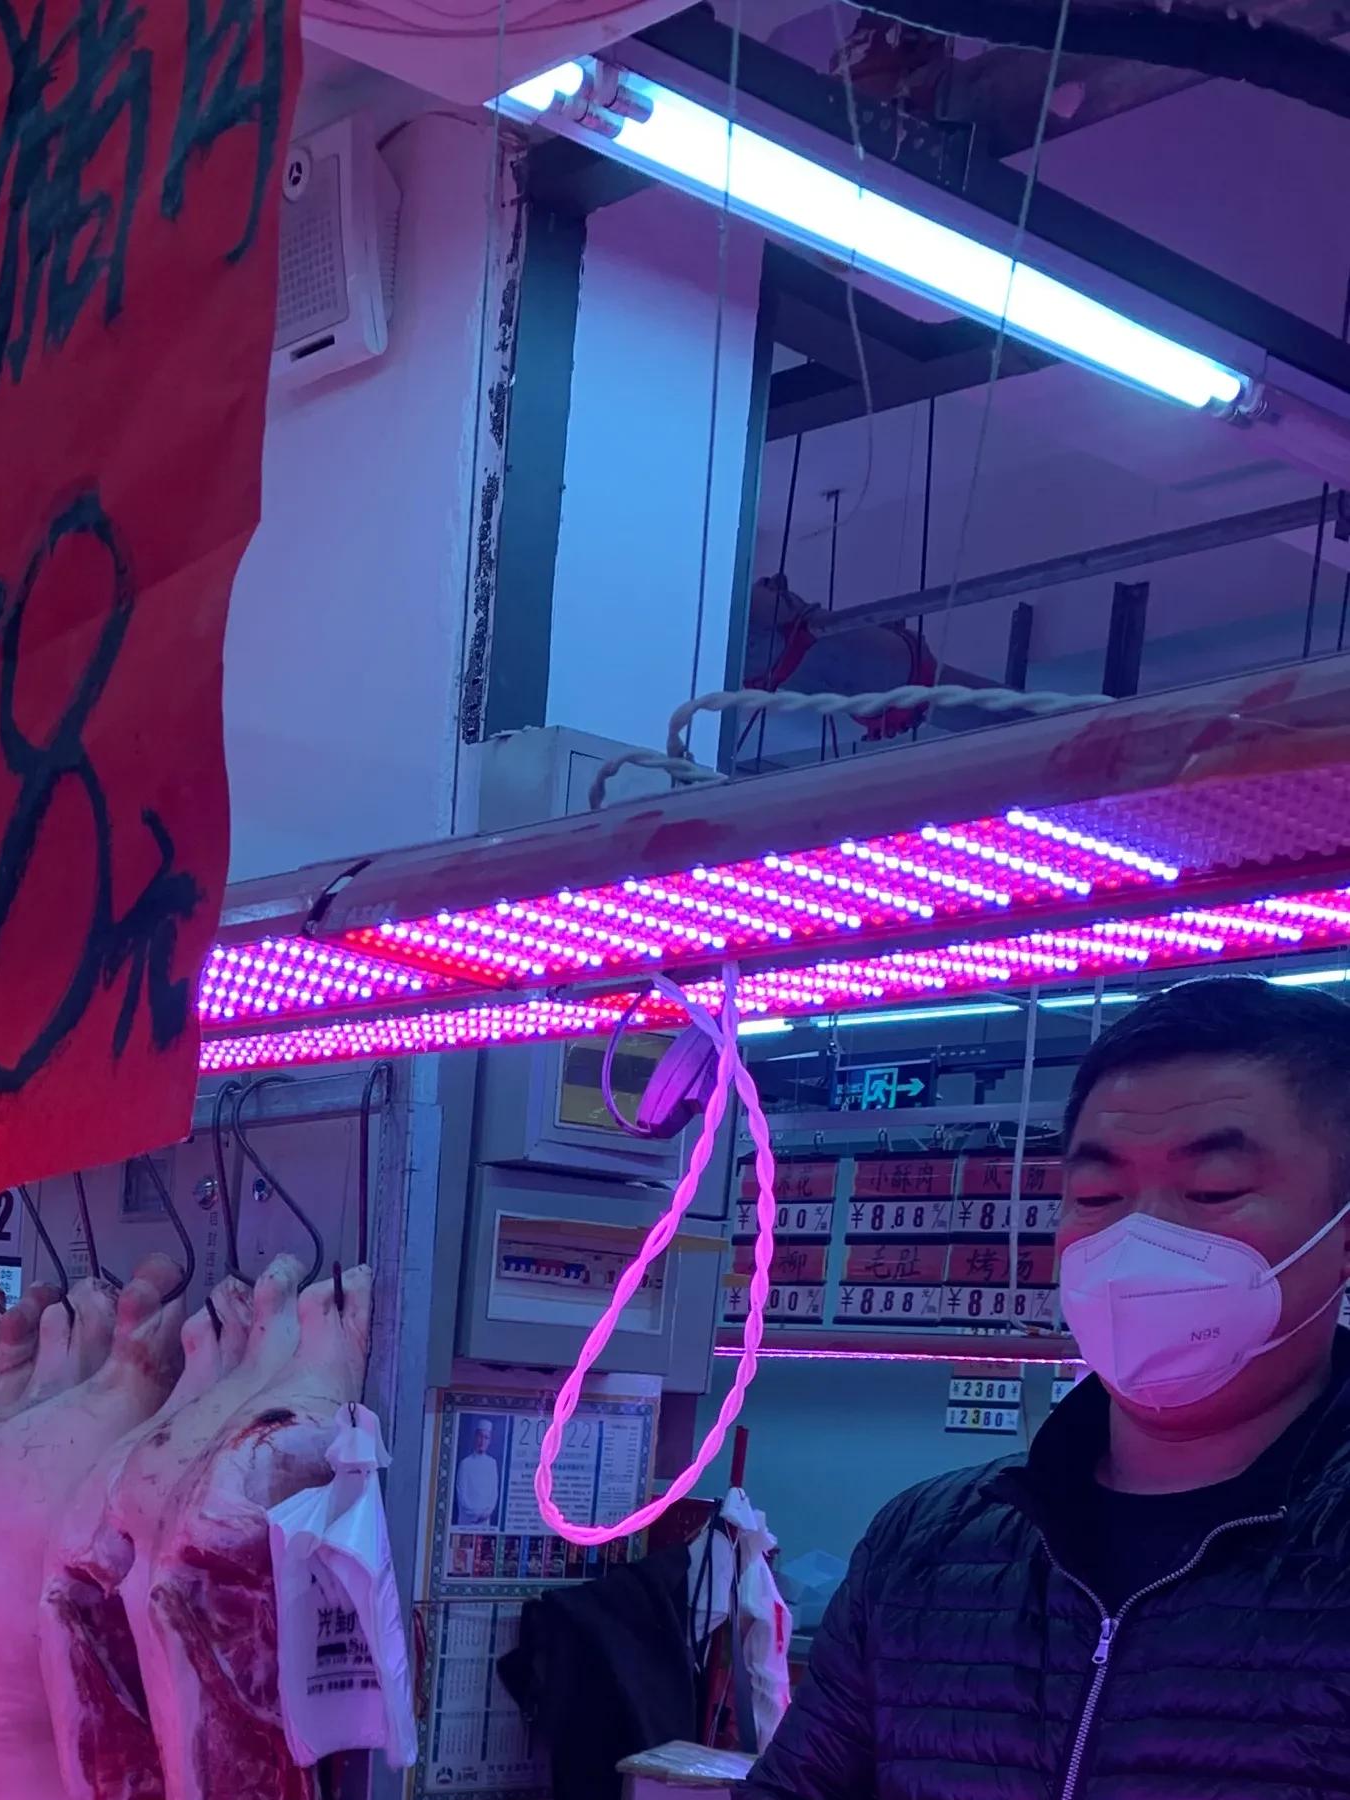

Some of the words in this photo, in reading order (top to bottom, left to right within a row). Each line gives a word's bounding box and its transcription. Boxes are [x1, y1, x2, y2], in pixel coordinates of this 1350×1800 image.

[737, 1204, 807, 1231] ¥.00
[729, 1287, 799, 1312] ¥.00
[1190, 1327, 1221, 1342] N95
